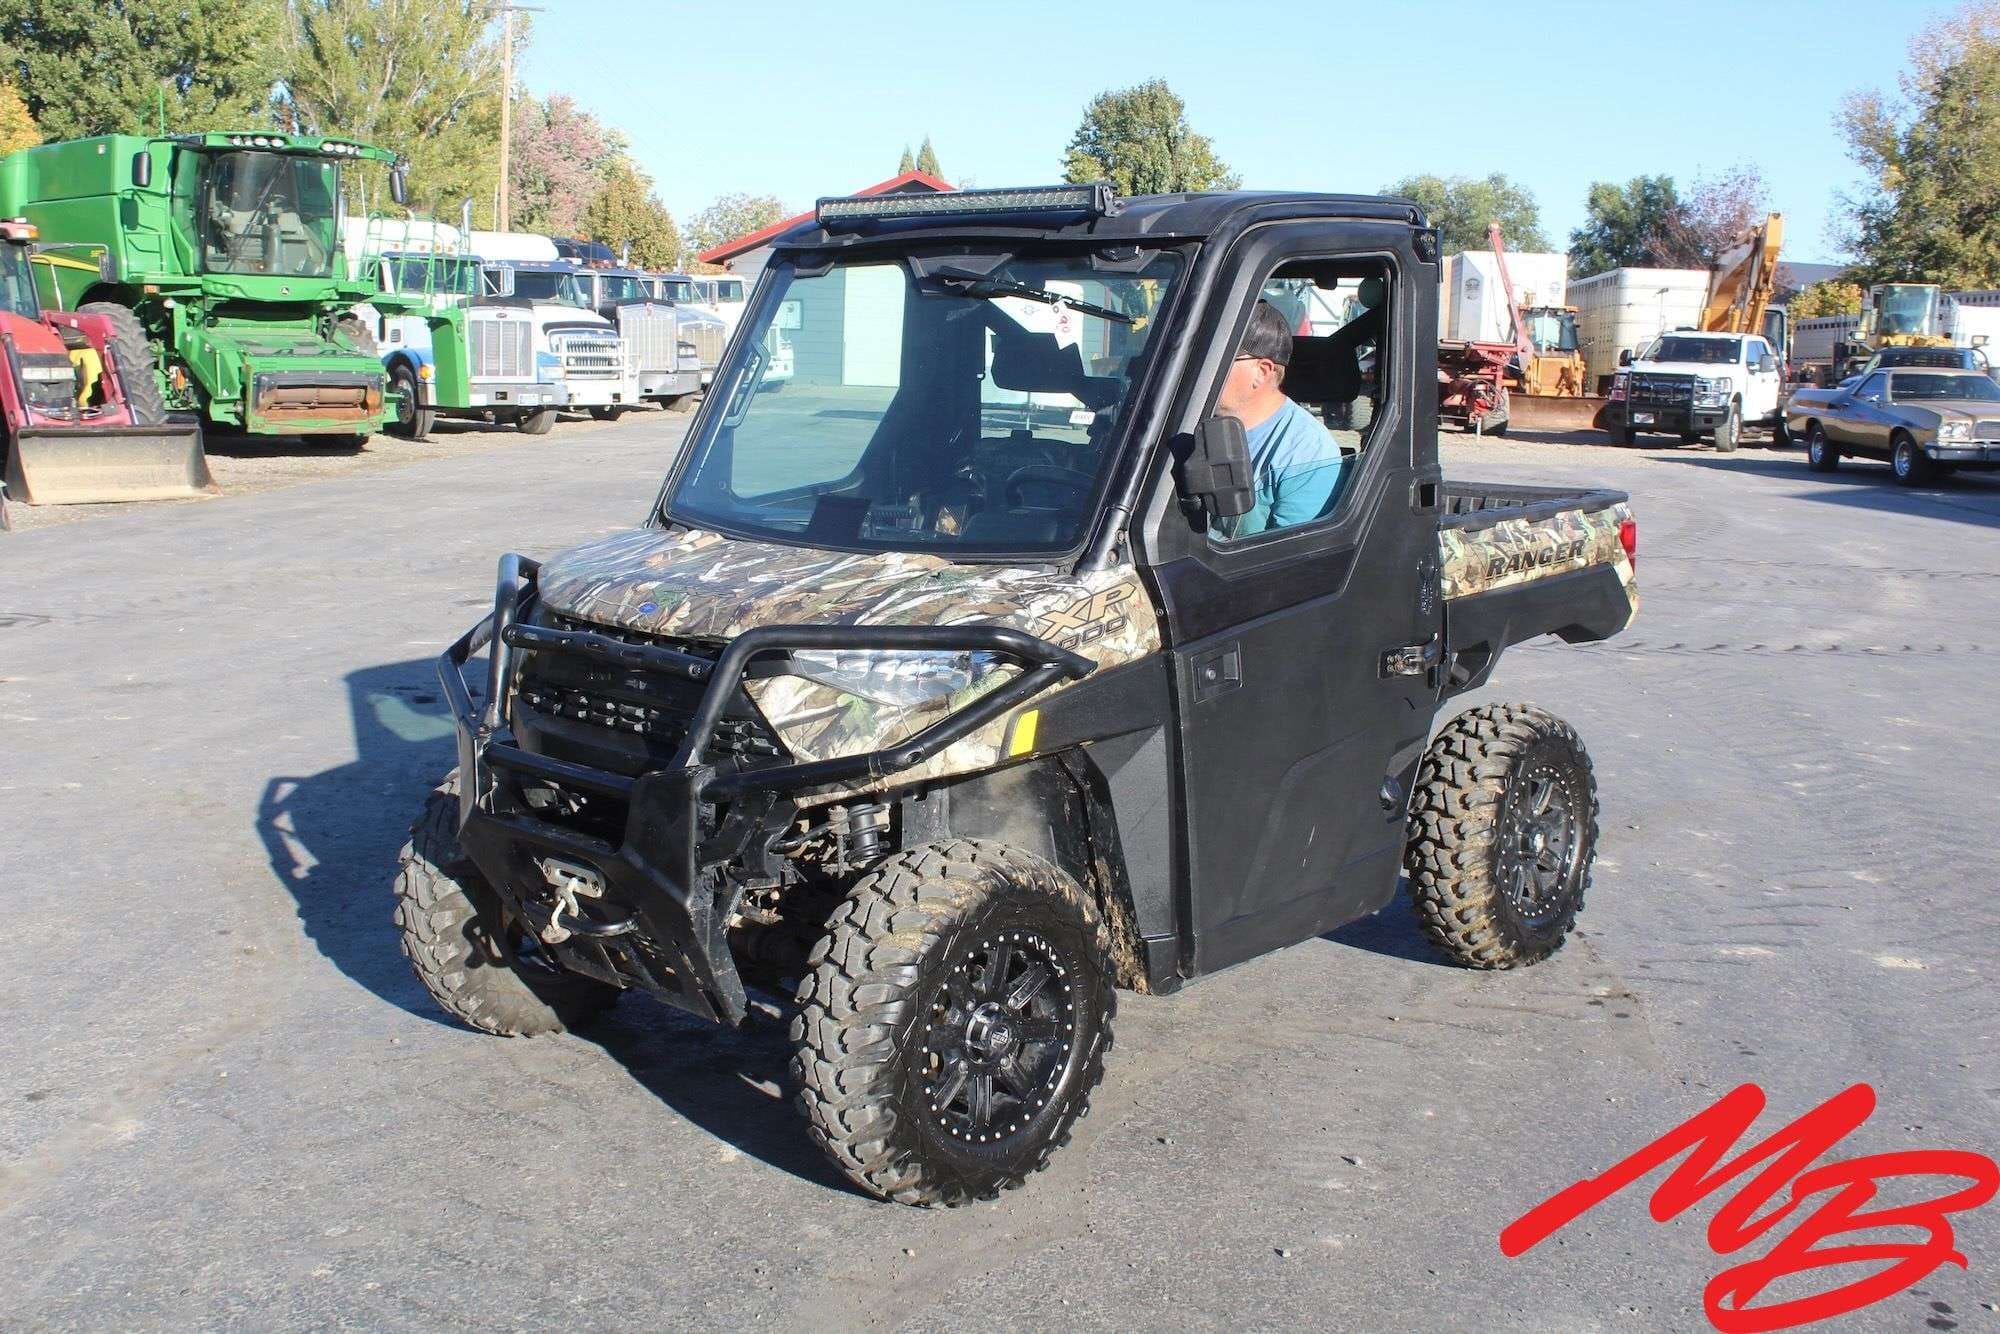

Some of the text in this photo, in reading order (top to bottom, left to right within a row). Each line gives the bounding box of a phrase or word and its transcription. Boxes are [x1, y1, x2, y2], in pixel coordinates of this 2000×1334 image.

[1486, 540, 1585, 580] RANGER
[1039, 581, 1136, 641] XP
[1056, 615, 1128, 650] 000
